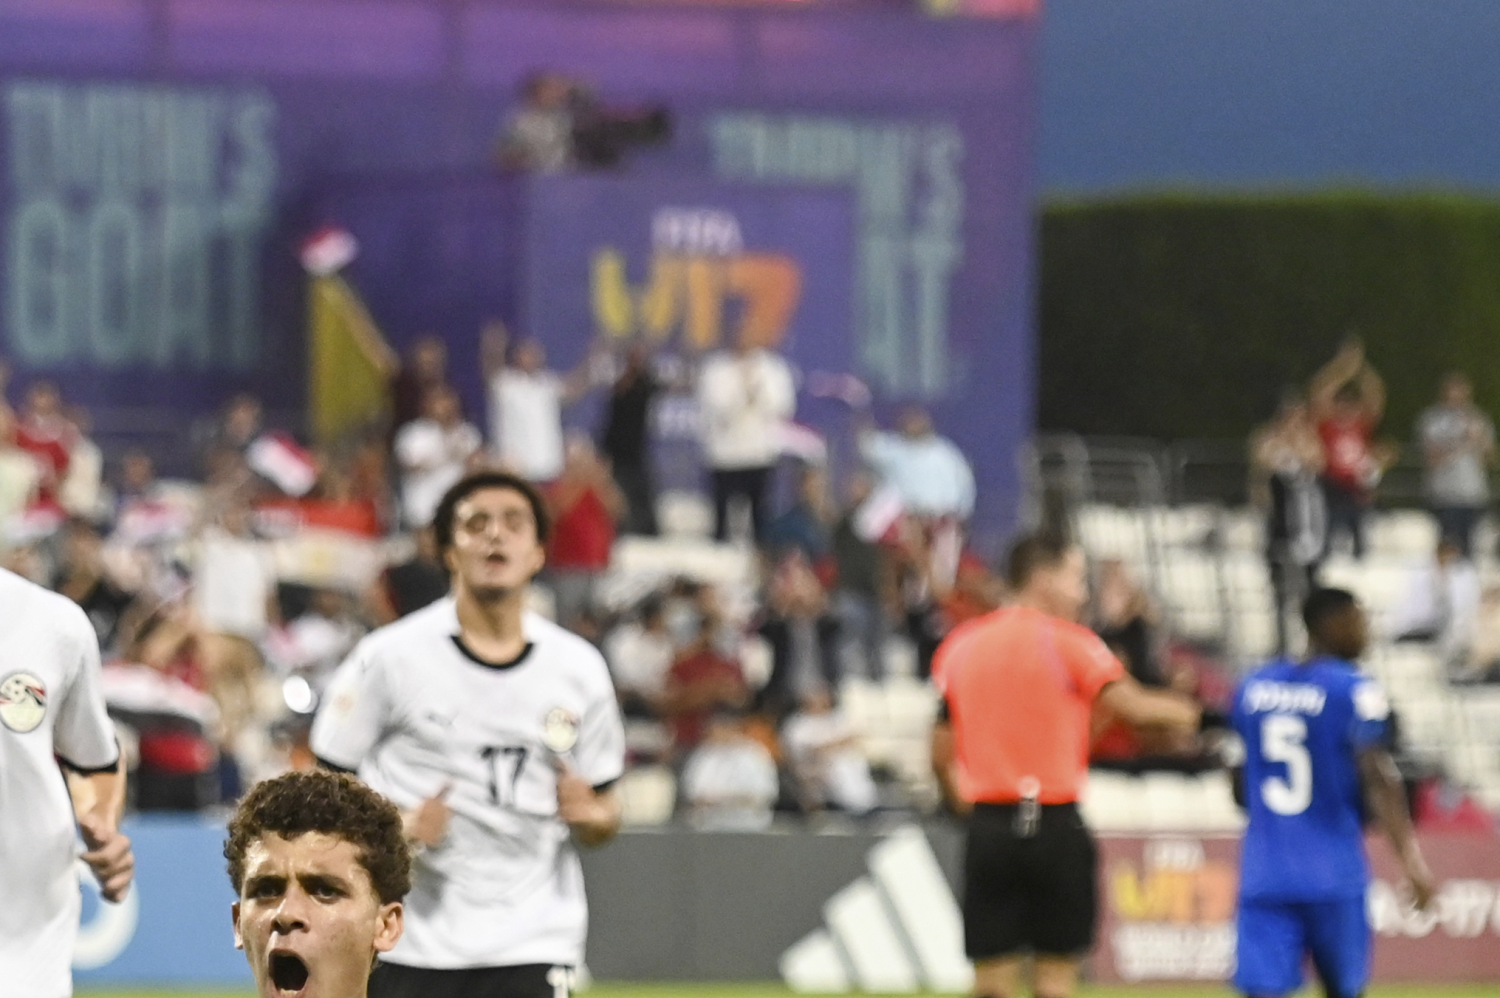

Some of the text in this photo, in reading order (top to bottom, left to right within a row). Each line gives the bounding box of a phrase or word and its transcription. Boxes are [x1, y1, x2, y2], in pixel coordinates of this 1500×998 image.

[6, 196, 266, 368] GOAT
[479, 746, 527, 808] 17
[1261, 714, 1313, 816] 5
